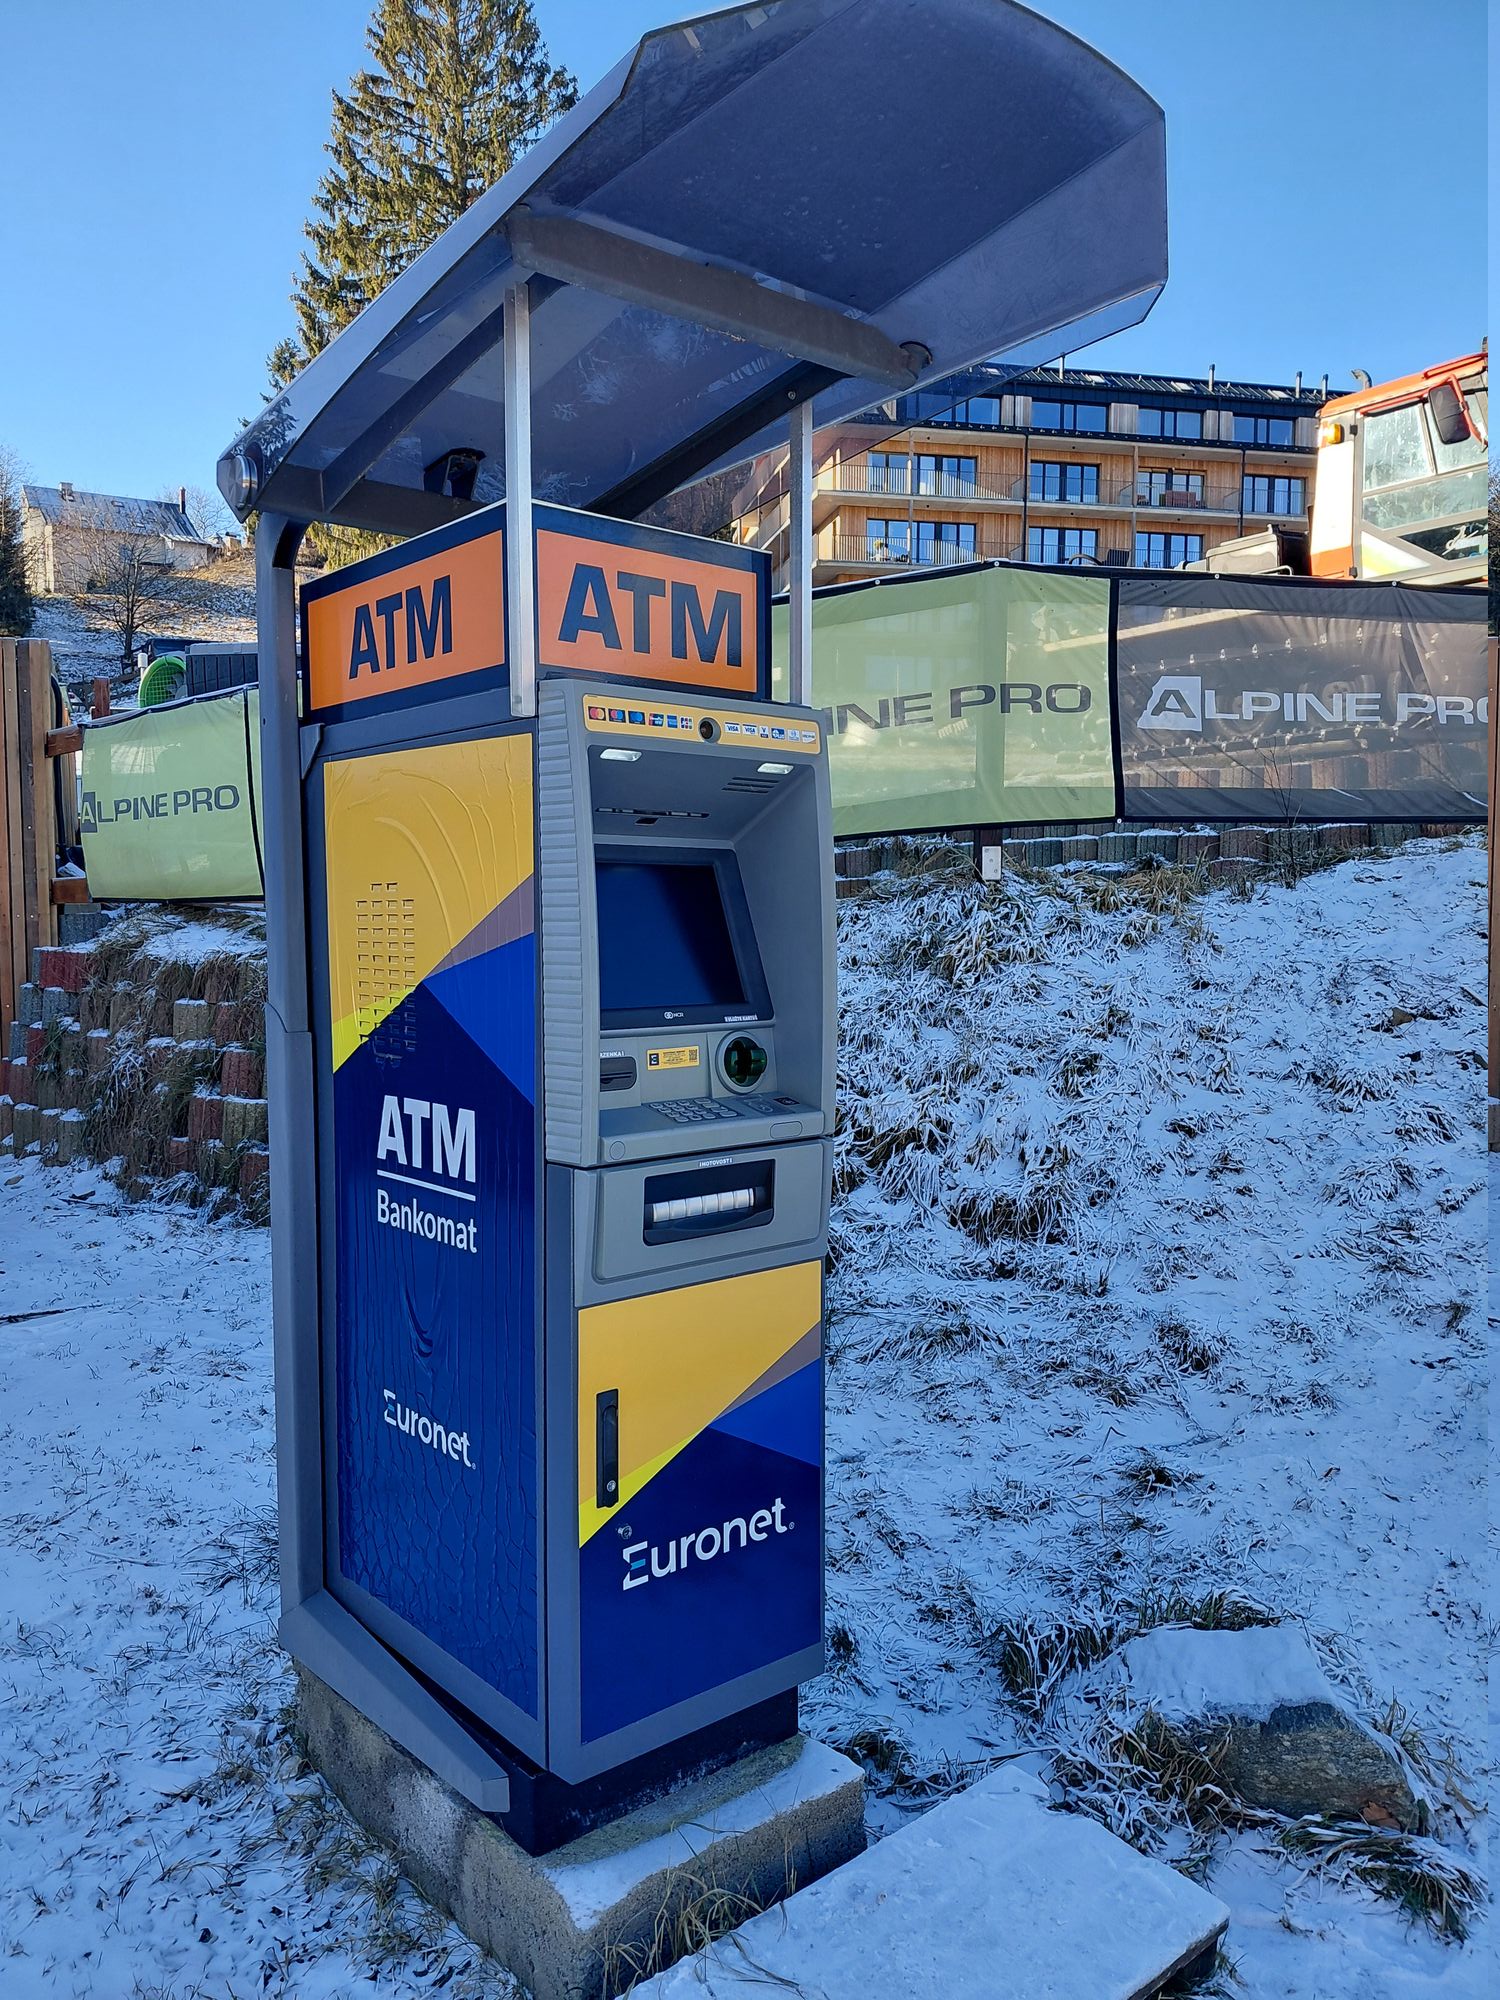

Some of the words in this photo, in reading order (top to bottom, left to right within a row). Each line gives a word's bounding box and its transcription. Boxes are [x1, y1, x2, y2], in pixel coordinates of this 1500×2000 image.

[348, 574, 454, 681] ATM
[557, 562, 743, 668] ATM
[949, 683, 1092, 717] PRO
[1138, 678, 1382, 729] ALPINE
[81, 792, 170, 830] ALPINE
[174, 784, 240, 816] PRO
[376, 1094, 477, 1183] ATM
[376, 1188, 478, 1254] Bankomat
[382, 1388, 473, 1470] Euronet
[621, 1496, 789, 1592] Euronet
